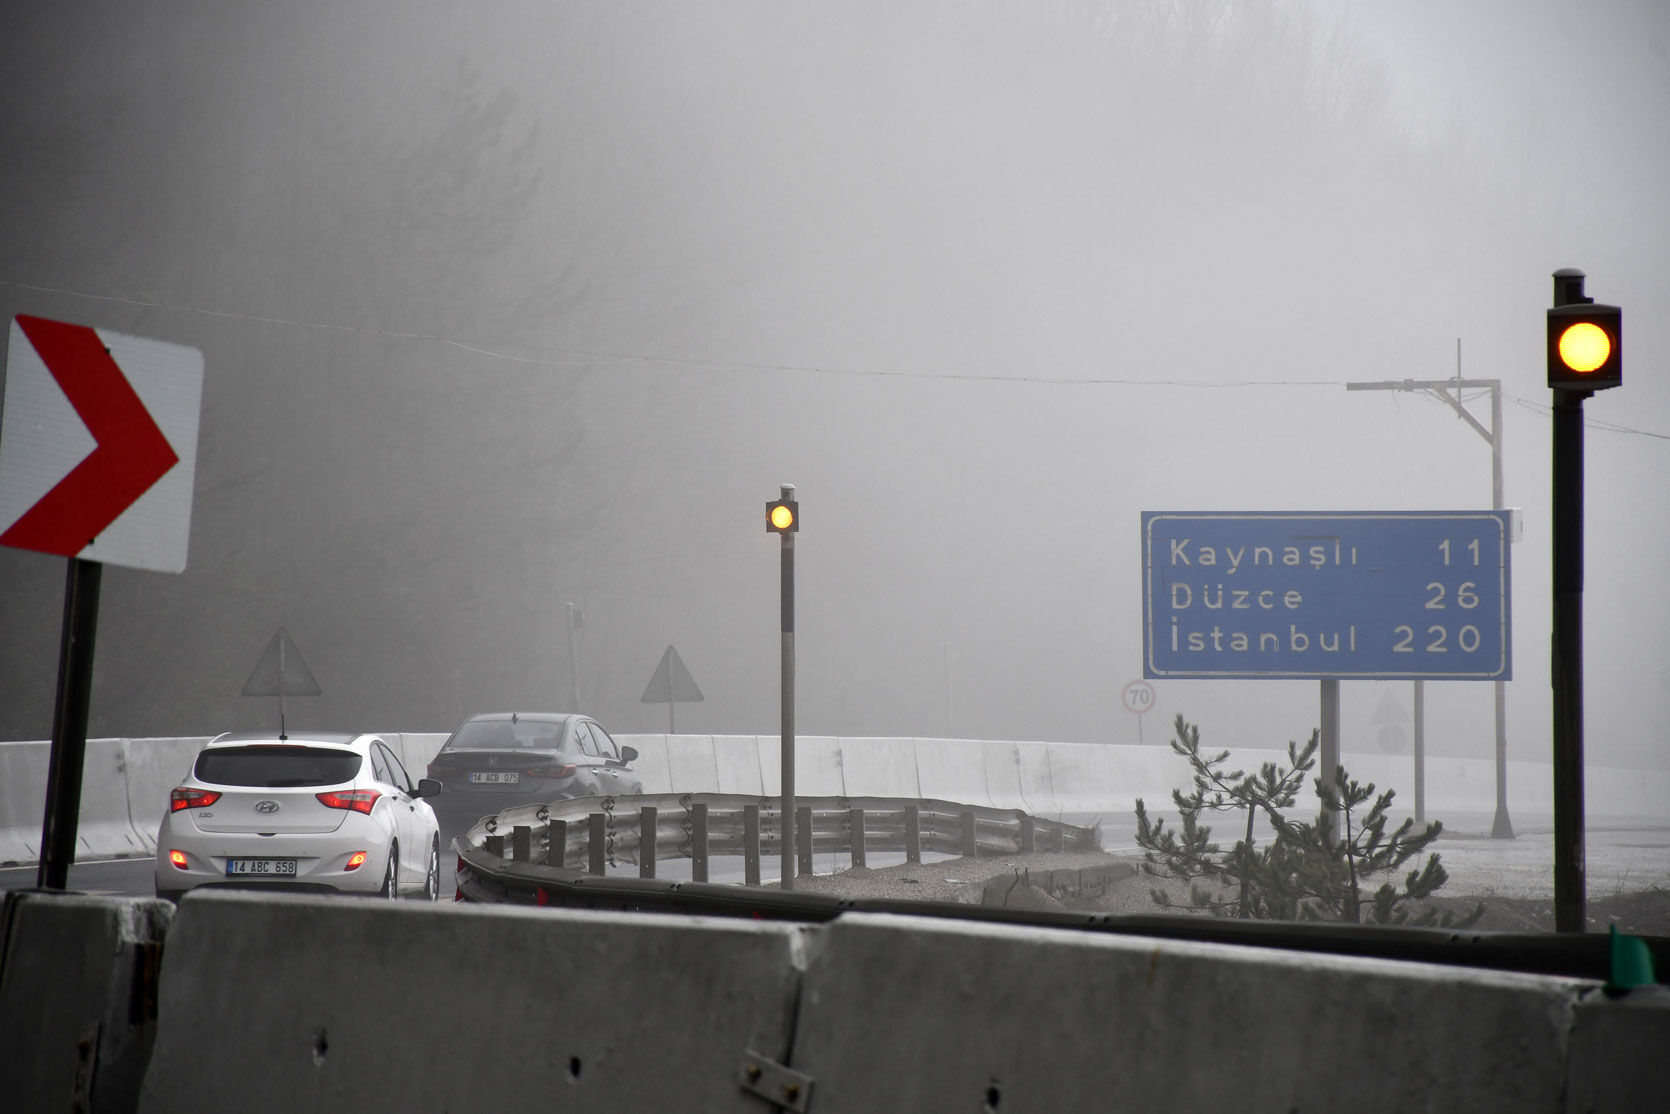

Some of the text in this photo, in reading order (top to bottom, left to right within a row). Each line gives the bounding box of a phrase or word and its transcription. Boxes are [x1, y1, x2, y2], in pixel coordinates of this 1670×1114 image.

[1170, 538, 1480, 574] Kaynaşlı 11
[1170, 581, 1480, 610] Düzce 26
[1171, 616, 1481, 653] İstanbul 220
[1129, 688, 1150, 706] 70
[473, 773, 482, 782] 14
[234, 861, 294, 873] 14 ABC 658
